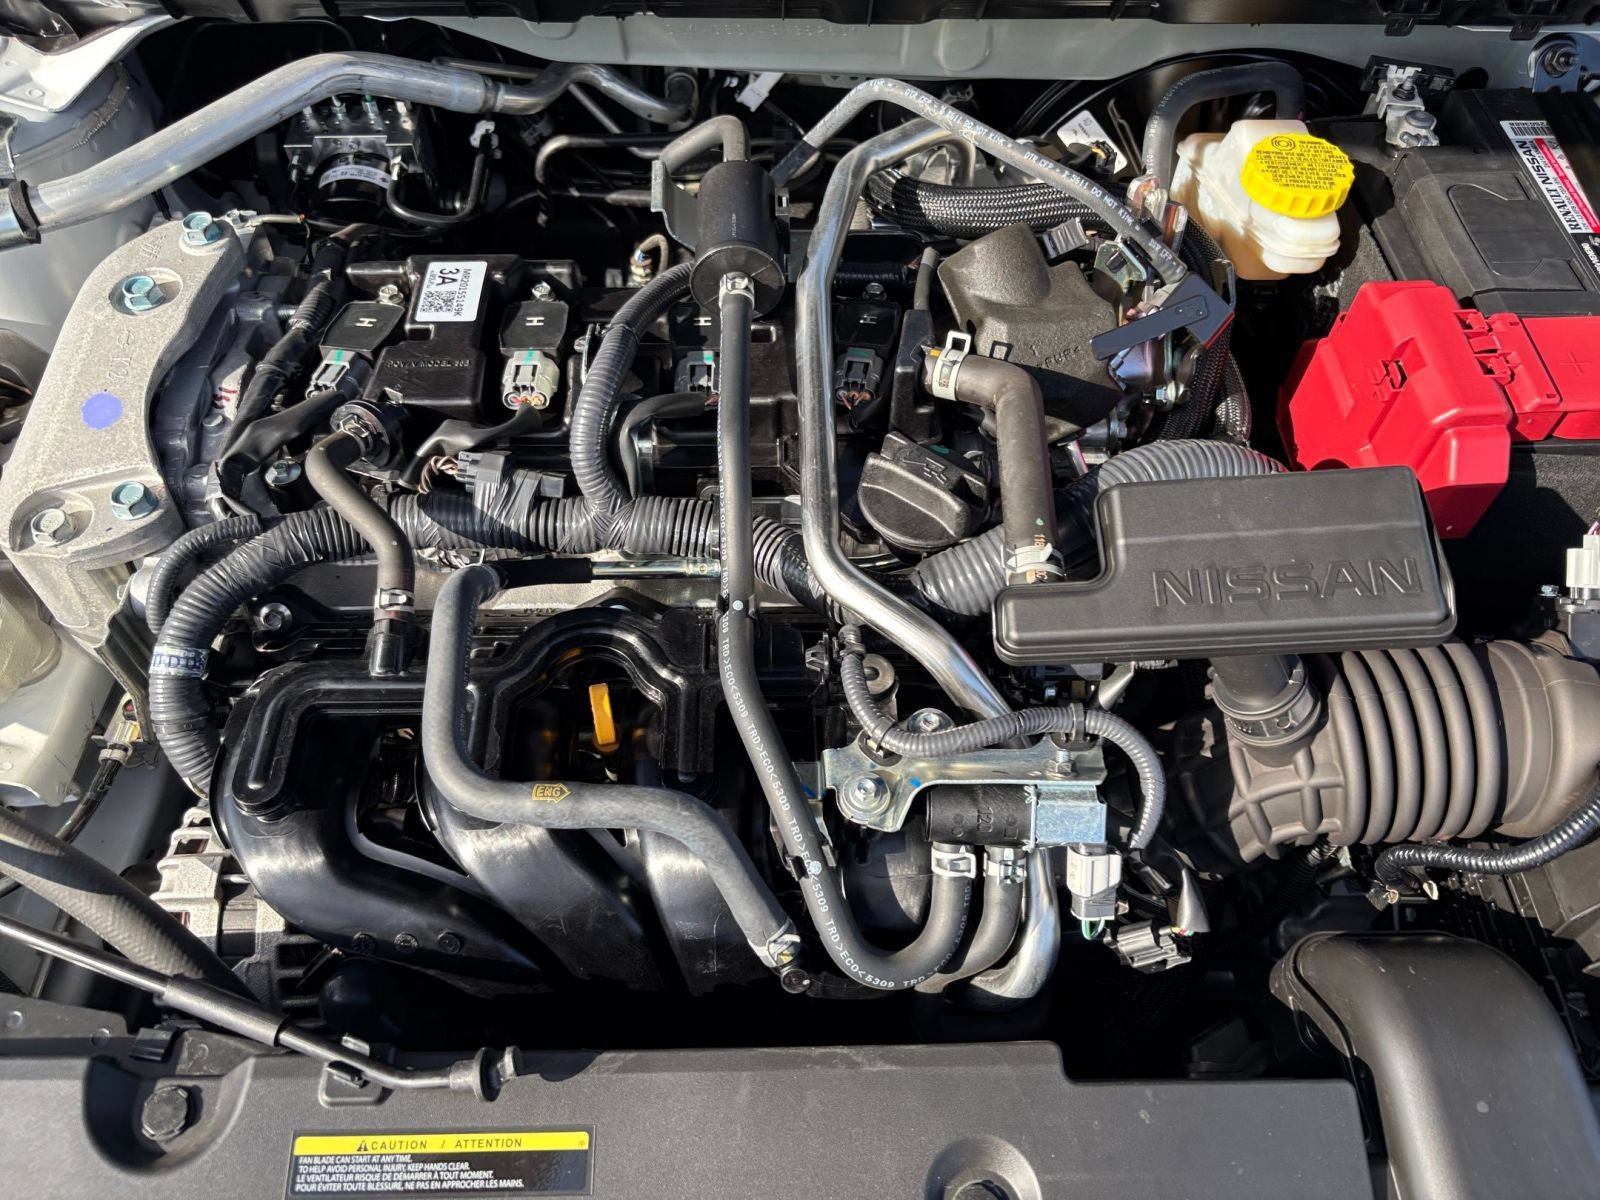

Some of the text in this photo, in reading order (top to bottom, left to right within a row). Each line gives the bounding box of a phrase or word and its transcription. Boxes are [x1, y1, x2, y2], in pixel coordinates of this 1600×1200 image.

[1516, 140, 1553, 185] NISSAN
[1545, 187, 1582, 231] RENAULT
[436, 268, 460, 286] 3A
[355, 317, 377, 327] H
[525, 317, 545, 326] H
[1152, 557, 1423, 607] NISSAN
[536, 786, 561, 797] ENG
[722, 637, 749, 718] TRD>ECO<5309
[747, 722, 791, 811] TRD>ECO<5309
[826, 917, 895, 988] TRD>ECO<5309
[371, 1140, 428, 1150] CAUTION
[454, 1138, 522, 1149] ATTENTION
[299, 1156, 312, 1164] FAN
[314, 1155, 335, 1164] BLADE
[336, 1155, 350, 1164] CAN
[351, 1154, 371, 1163] START
[371, 1154, 380, 1163] AT
[299, 1165, 308, 1173] TO
[309, 1165, 326, 1173] HELP
[326, 1164, 347, 1173] AVOID
[348, 1163, 381, 1172] PERSONAL
[407, 1163, 423, 1172] KEEP
[424, 1162, 447, 1171] HANDS
[448, 1162, 470, 1171] CLEAR.
[297, 1174, 306, 1183] LE
[306, 1173, 353, 1182] VENTILATEUR
[354, 1172, 380, 1182] RISQUE
[382, 1172, 392, 1181] DE
[439, 1171, 459, 1180] TOUT
[460, 1170, 494, 1179] MOMENT.
[295, 1183, 316, 1192] POUR
[343, 1182, 366, 1191] TOUTE
[405, 1181, 415, 1190] NE
[415, 1181, 429, 1190] PAS
[430, 1180, 441, 1189] EN
[441, 1180, 485, 1189] APPROCHER
[485, 1179, 498, 1188] LES
[499, 1178, 525, 1187] MAINS.
